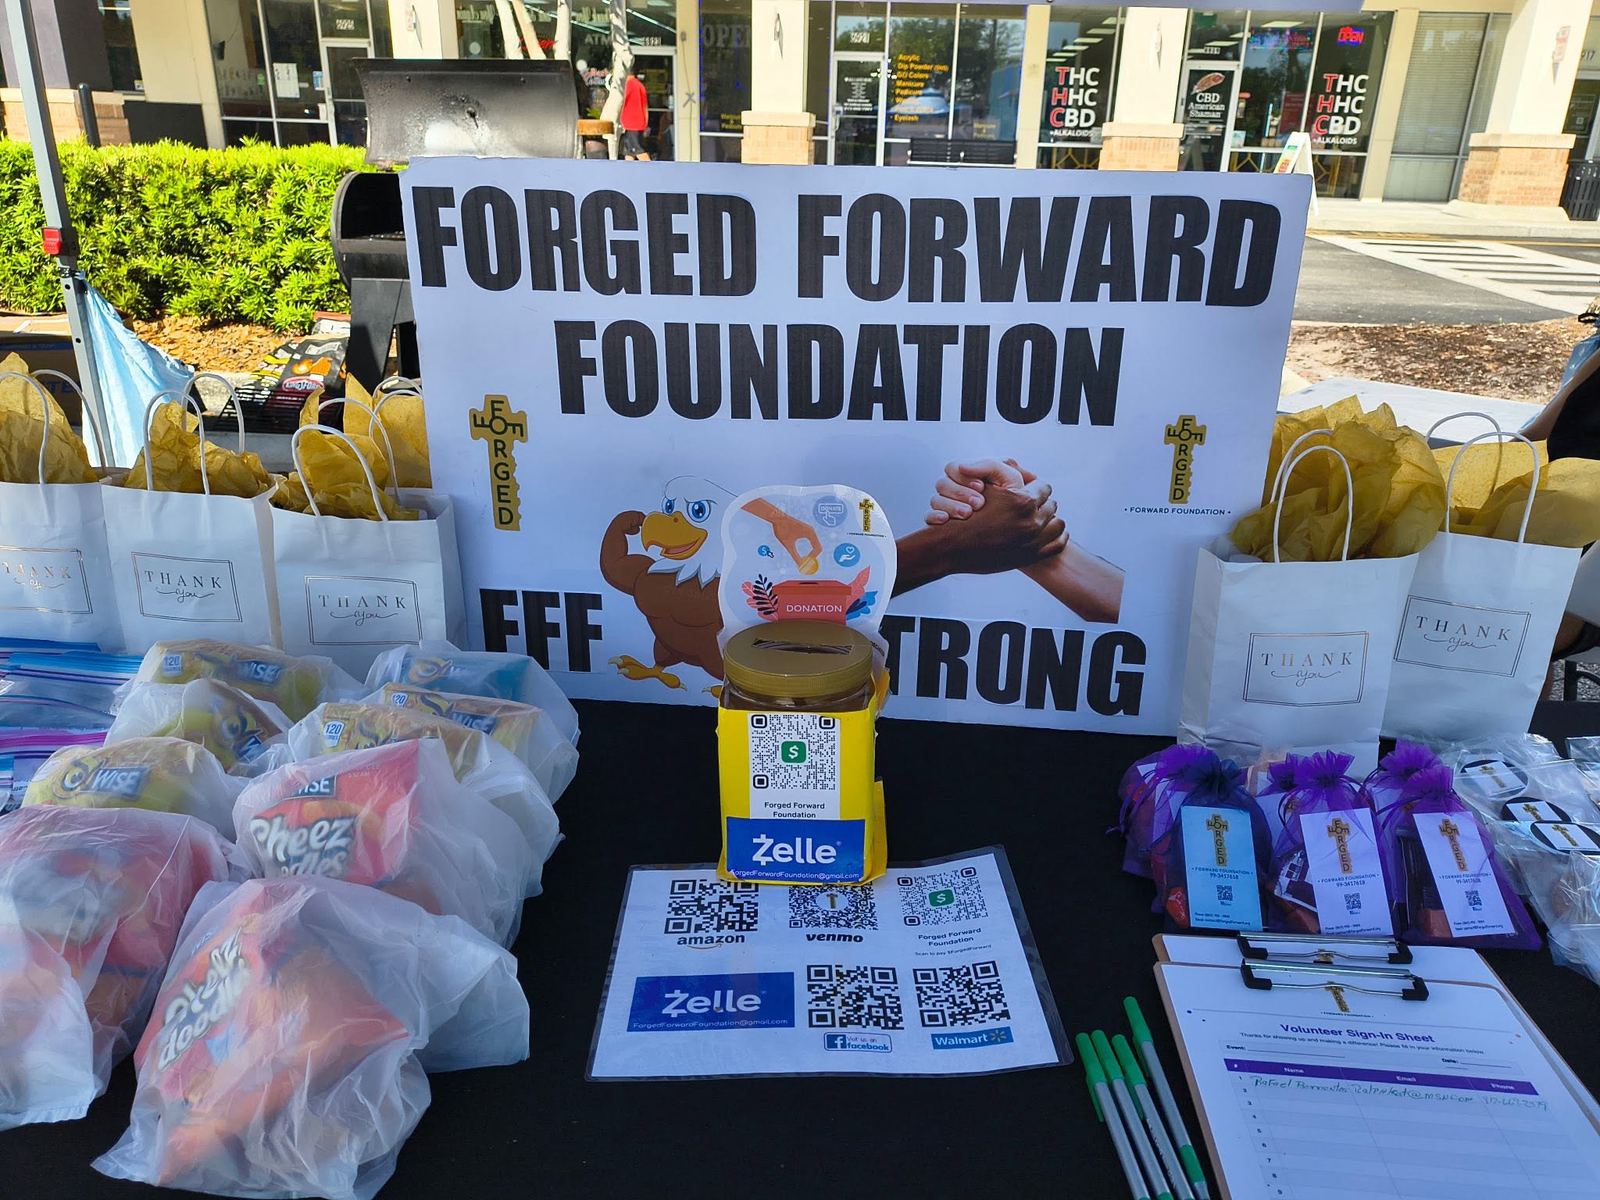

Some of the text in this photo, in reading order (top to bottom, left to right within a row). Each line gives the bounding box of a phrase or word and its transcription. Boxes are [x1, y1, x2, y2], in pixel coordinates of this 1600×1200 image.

[1055, 66, 1100, 87] THC
[1323, 73, 1369, 93] THC
[1051, 87, 1098, 107] HHC
[1188, 102, 1225, 111] American
[1196, 92, 1220, 103] CBD
[1316, 95, 1366, 114] HHC
[1050, 108, 1096, 128] CBD
[1313, 115, 1361, 136] CBD
[412, 185, 1282, 307] FORGED FORWARD
[553, 320, 1125, 427] FOUNDATION
[1130, 506, 1169, 514] FORWARD
[2, 562, 71, 579] THANK
[144, 570, 222, 589] THANK
[318, 594, 407, 609] THANK
[786, 604, 842, 613] DONATION
[478, 589, 603, 673] FFF
[1416, 615, 1511, 641] THANK
[879, 614, 1148, 718] TRONG
[1261, 652, 1352, 667] THANK
[325, 724, 342, 734] 120
[91, 768, 141, 795] WISE
[299, 776, 331, 795] ISE
[764, 801, 825, 810] Forged Forward
[772, 811, 816, 819] Foundation
[250, 815, 355, 862] Cheez
[752, 833, 837, 866] Zelle
[677, 934, 745, 946] amazon
[806, 933, 863, 943] venmo
[928, 936, 974, 947] Foundation
[948, 928, 981, 938] Forward
[662, 989, 762, 1018] Zelle
[935, 1034, 988, 1046] Walmart
[1280, 1023, 1436, 1043] Volunteer Sign-In Sheet
[845, 1042, 889, 1051] facebook
